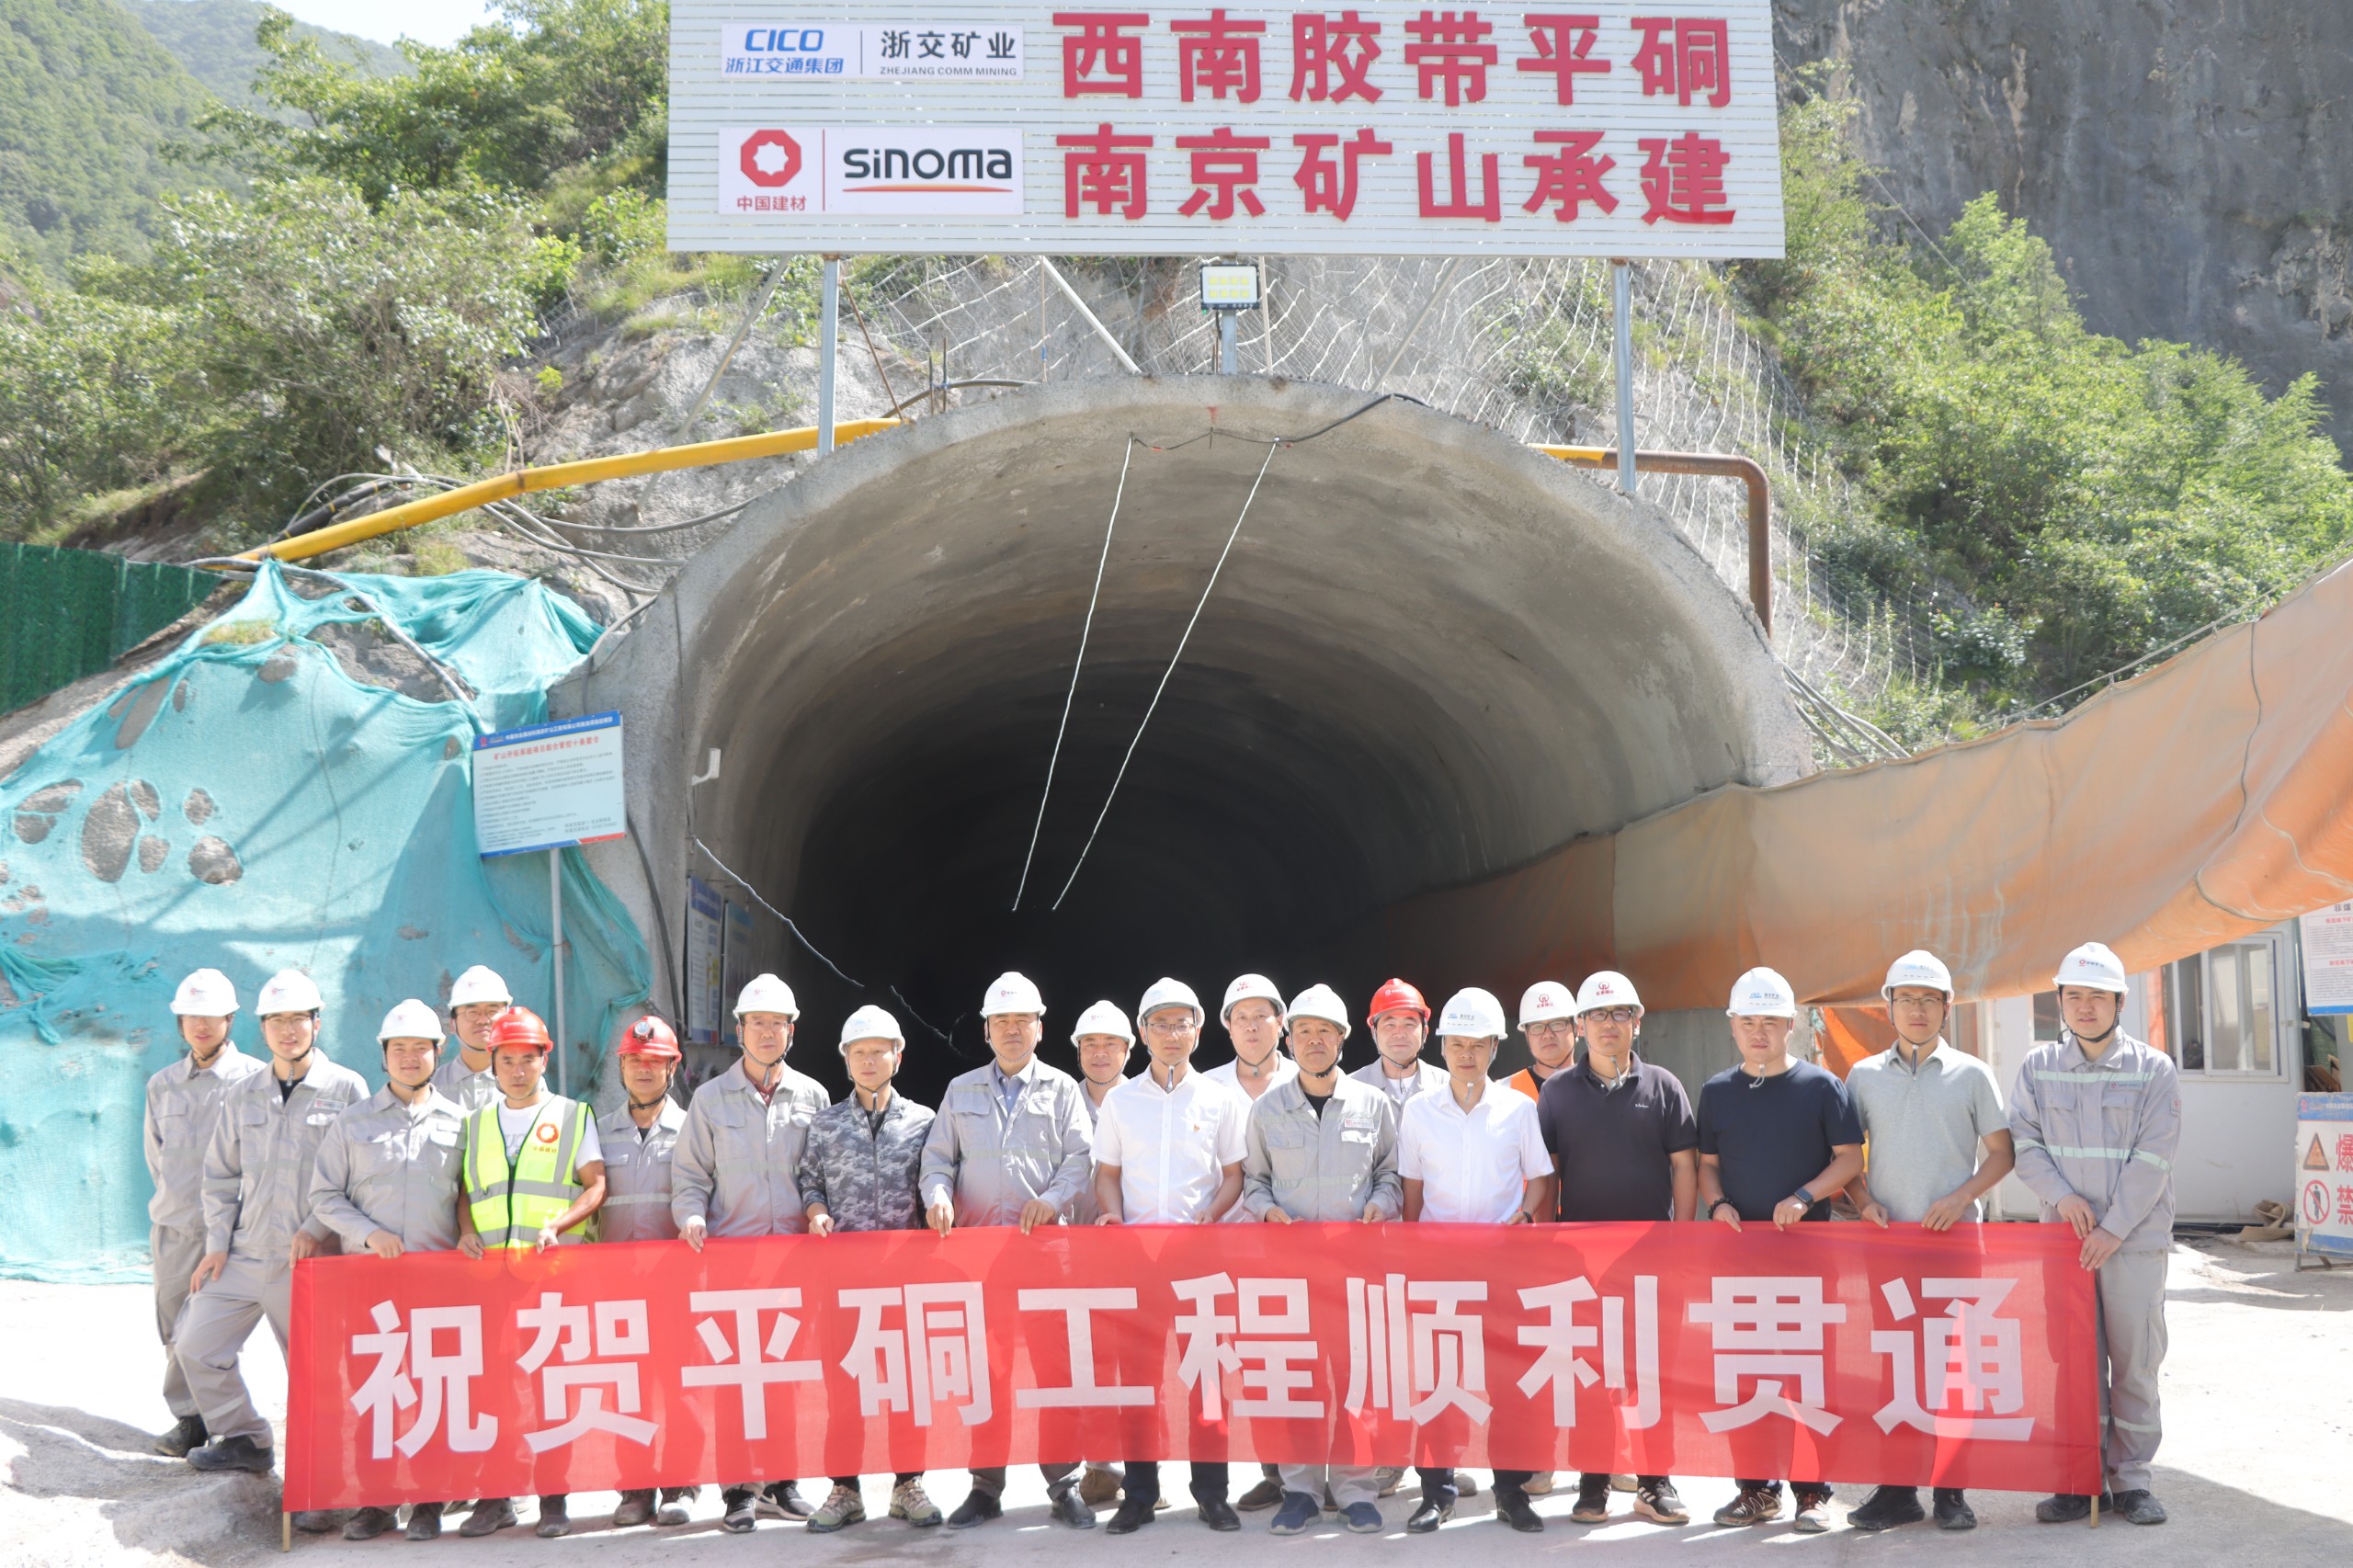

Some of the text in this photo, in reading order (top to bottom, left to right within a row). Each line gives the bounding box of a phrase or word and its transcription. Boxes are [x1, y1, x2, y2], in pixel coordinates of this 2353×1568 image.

[745, 29, 824, 51] CICO
[881, 30, 1017, 59] 浙交矿业
[725, 57, 844, 74] 浙江交通集团
[880, 66, 1017, 76] ZHEJIANG COMM MINING
[1053, 9, 1731, 107] 西南胶带平硐
[843, 148, 1012, 179] sinoma
[1056, 123, 1735, 224] 南京矿山承建
[737, 195, 807, 211] 中国建材
[350, 1271, 2036, 1460] 祝贺平硐工程顺利贯通
